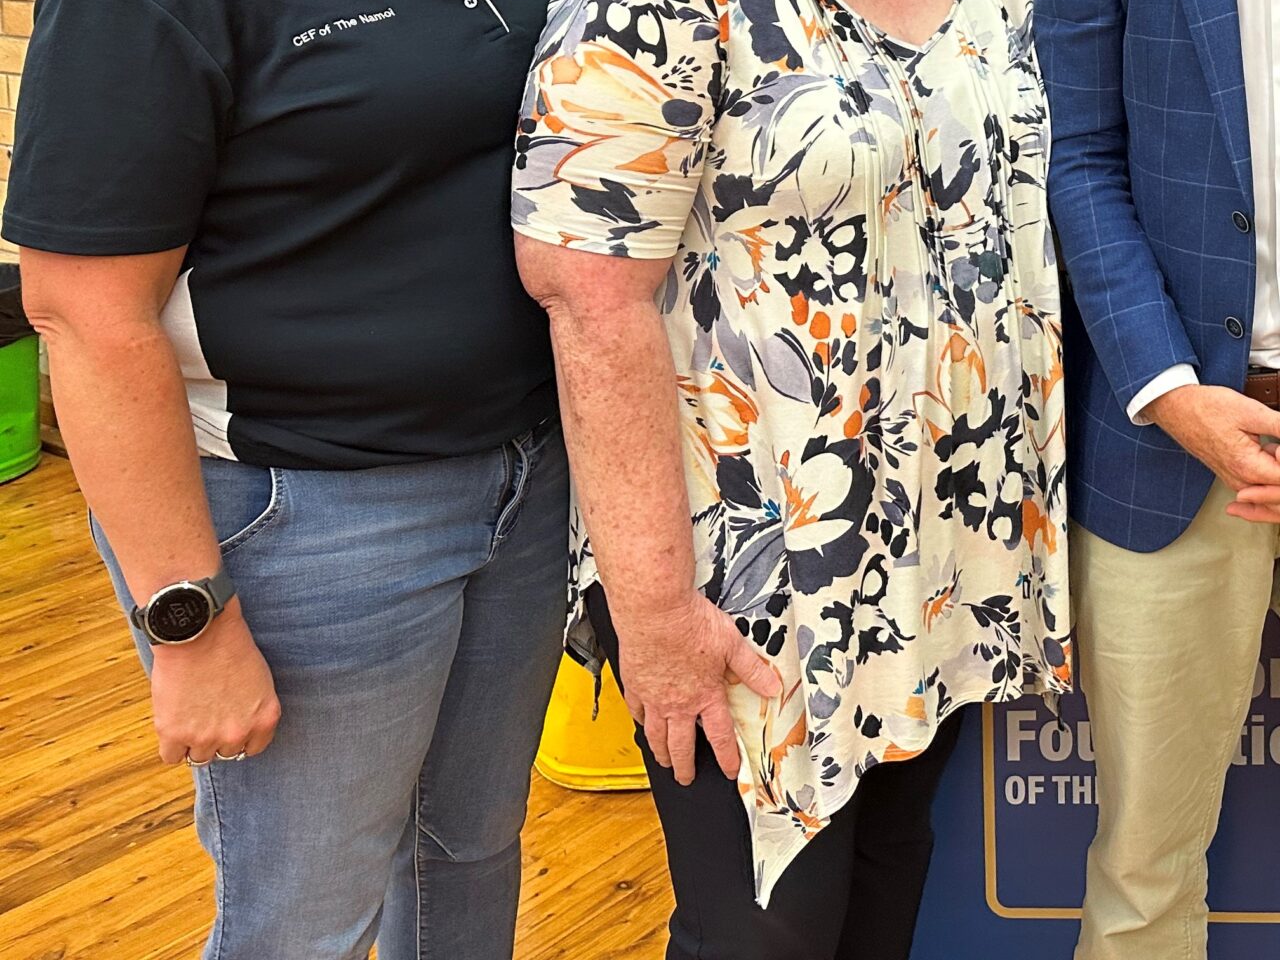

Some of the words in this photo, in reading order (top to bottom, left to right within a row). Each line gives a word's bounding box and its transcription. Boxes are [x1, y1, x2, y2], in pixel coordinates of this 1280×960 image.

[292, 28, 316, 47] CEF
[318, 23, 331, 36] of
[333, 18, 358, 31] The
[359, 7, 396, 24] Namoi
[1005, 775, 1045, 805] OF
[1051, 775, 1100, 805] TH
